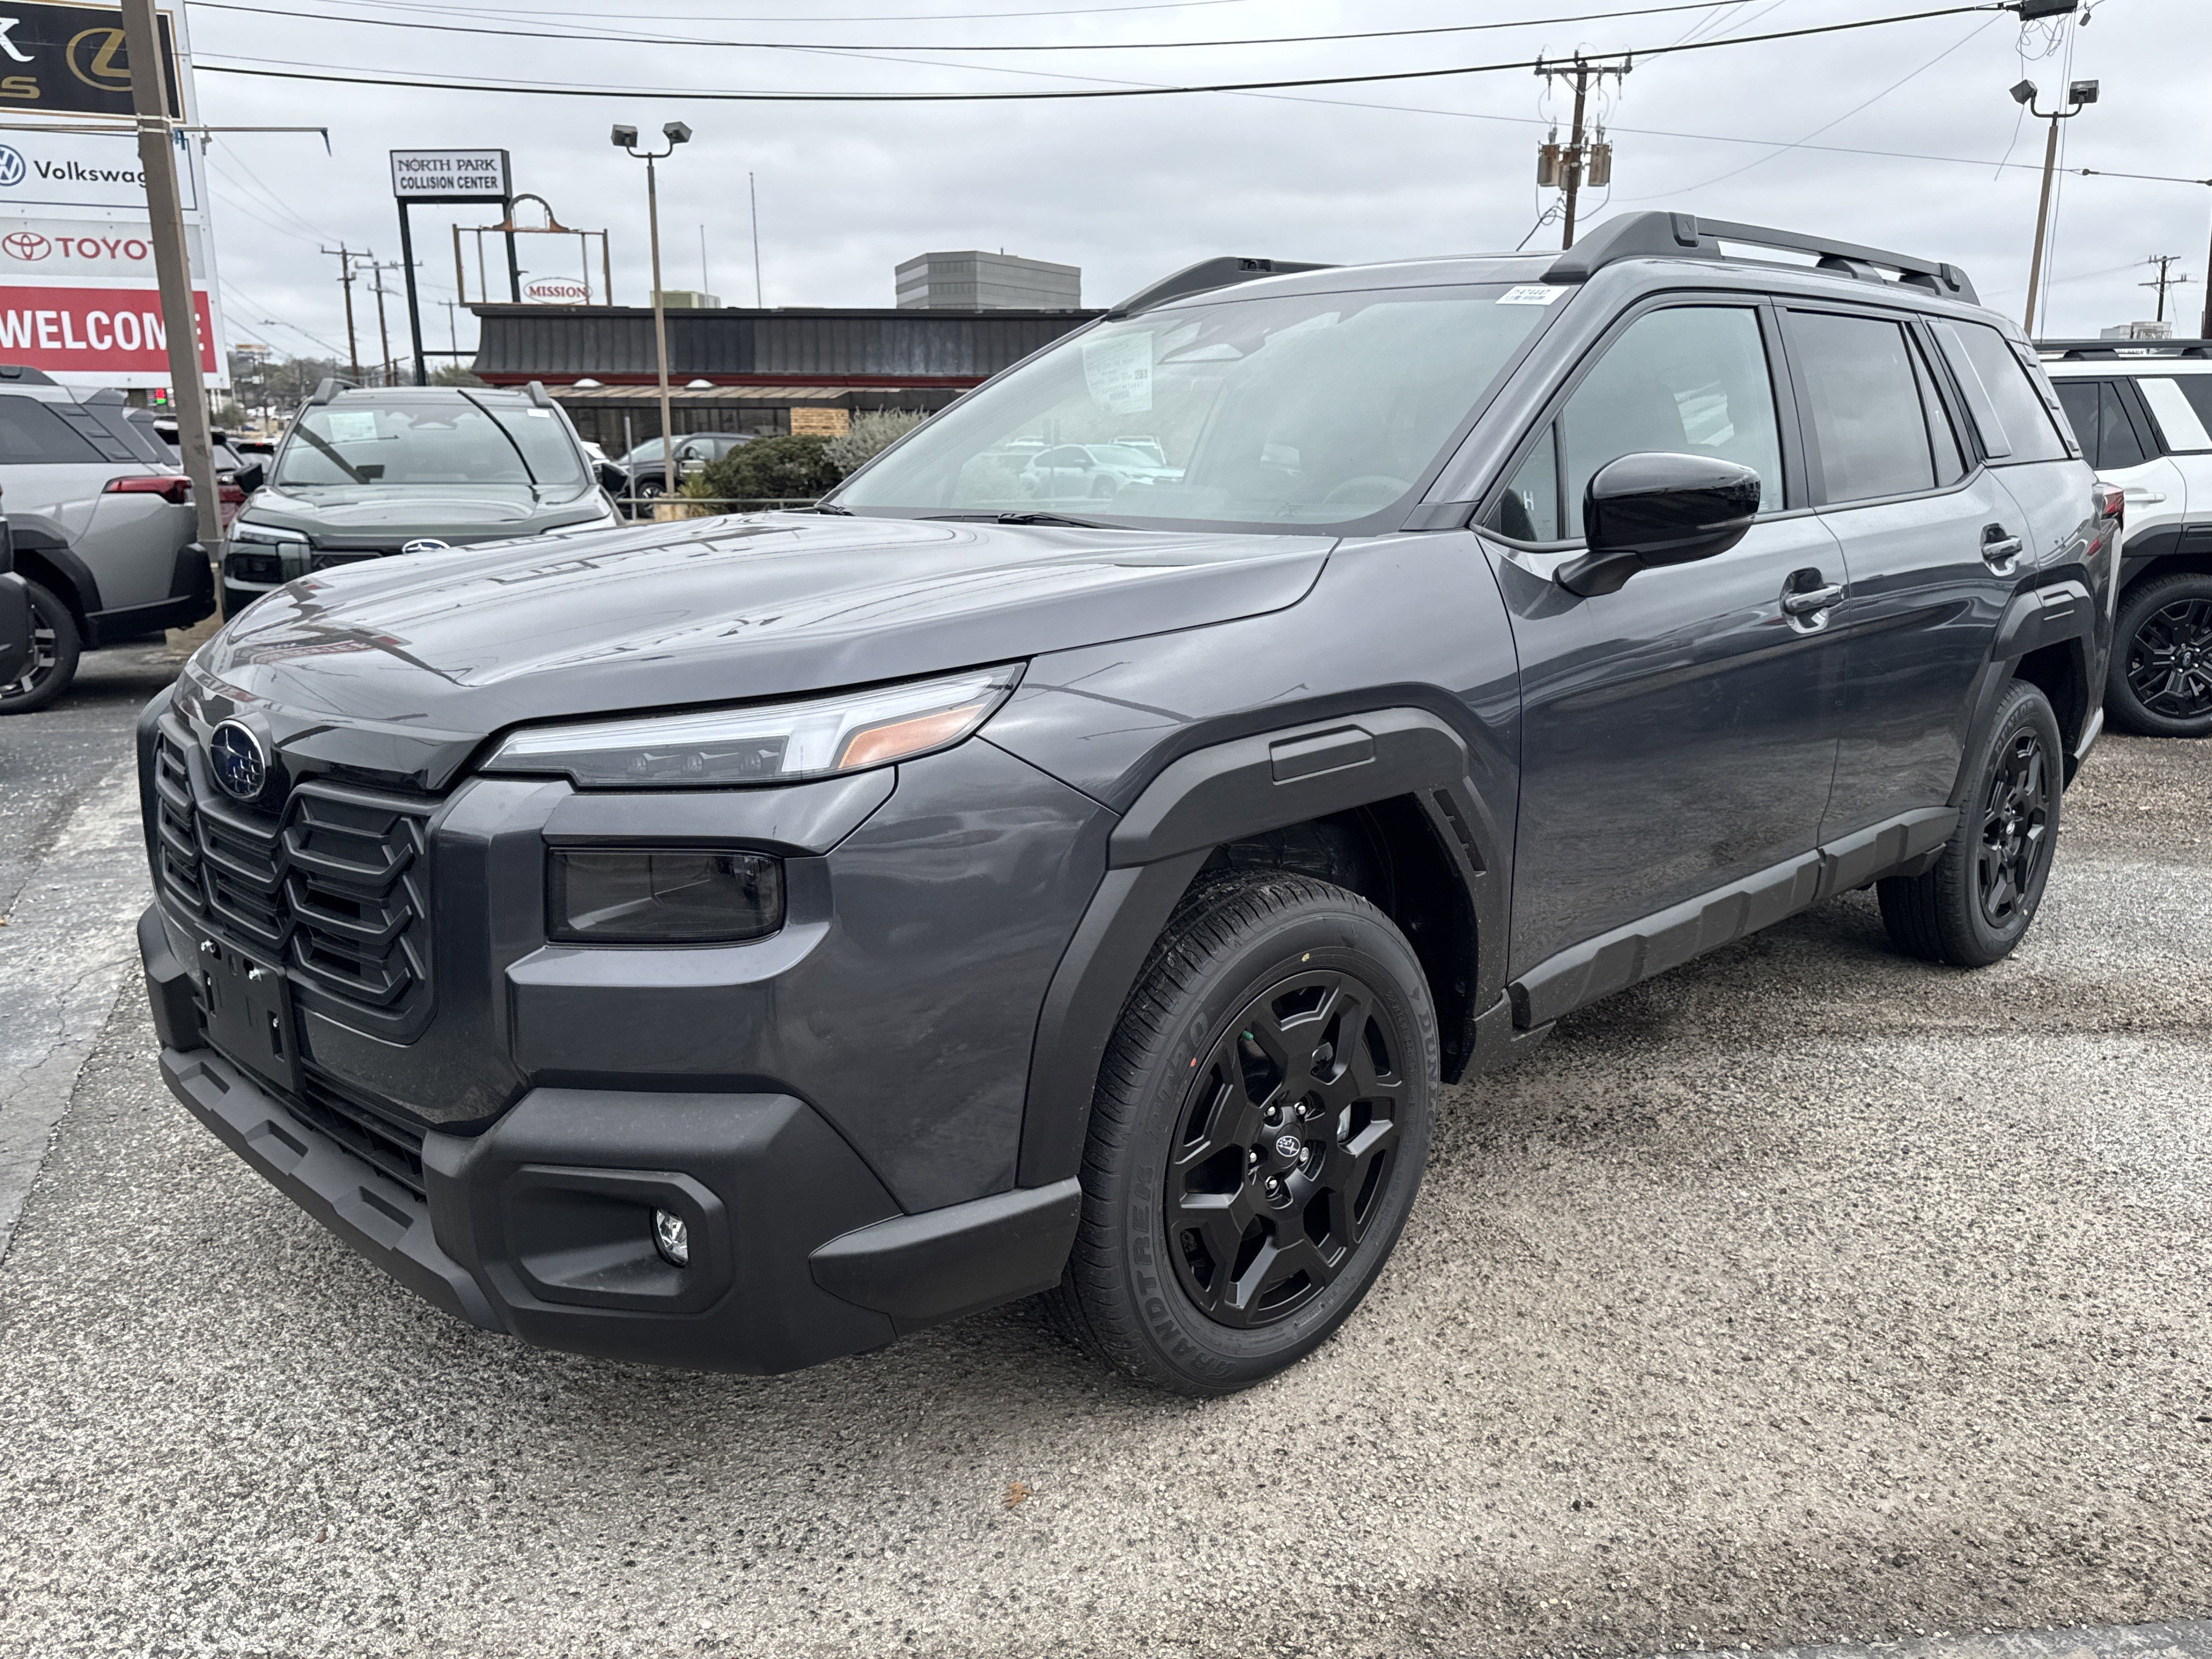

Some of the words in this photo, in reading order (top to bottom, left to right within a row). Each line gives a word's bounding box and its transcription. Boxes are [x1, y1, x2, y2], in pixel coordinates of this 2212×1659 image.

[398, 159, 450, 171] NORTH
[456, 159, 497, 171] PARK
[400, 176, 454, 189] COLLISION
[457, 176, 498, 189] CENTER
[55, 237, 154, 261] TOYO
[529, 286, 588, 297] MISSION
[0, 309, 204, 351] WELCOM
[1132, 1164, 1238, 1378] GRANDTREK
